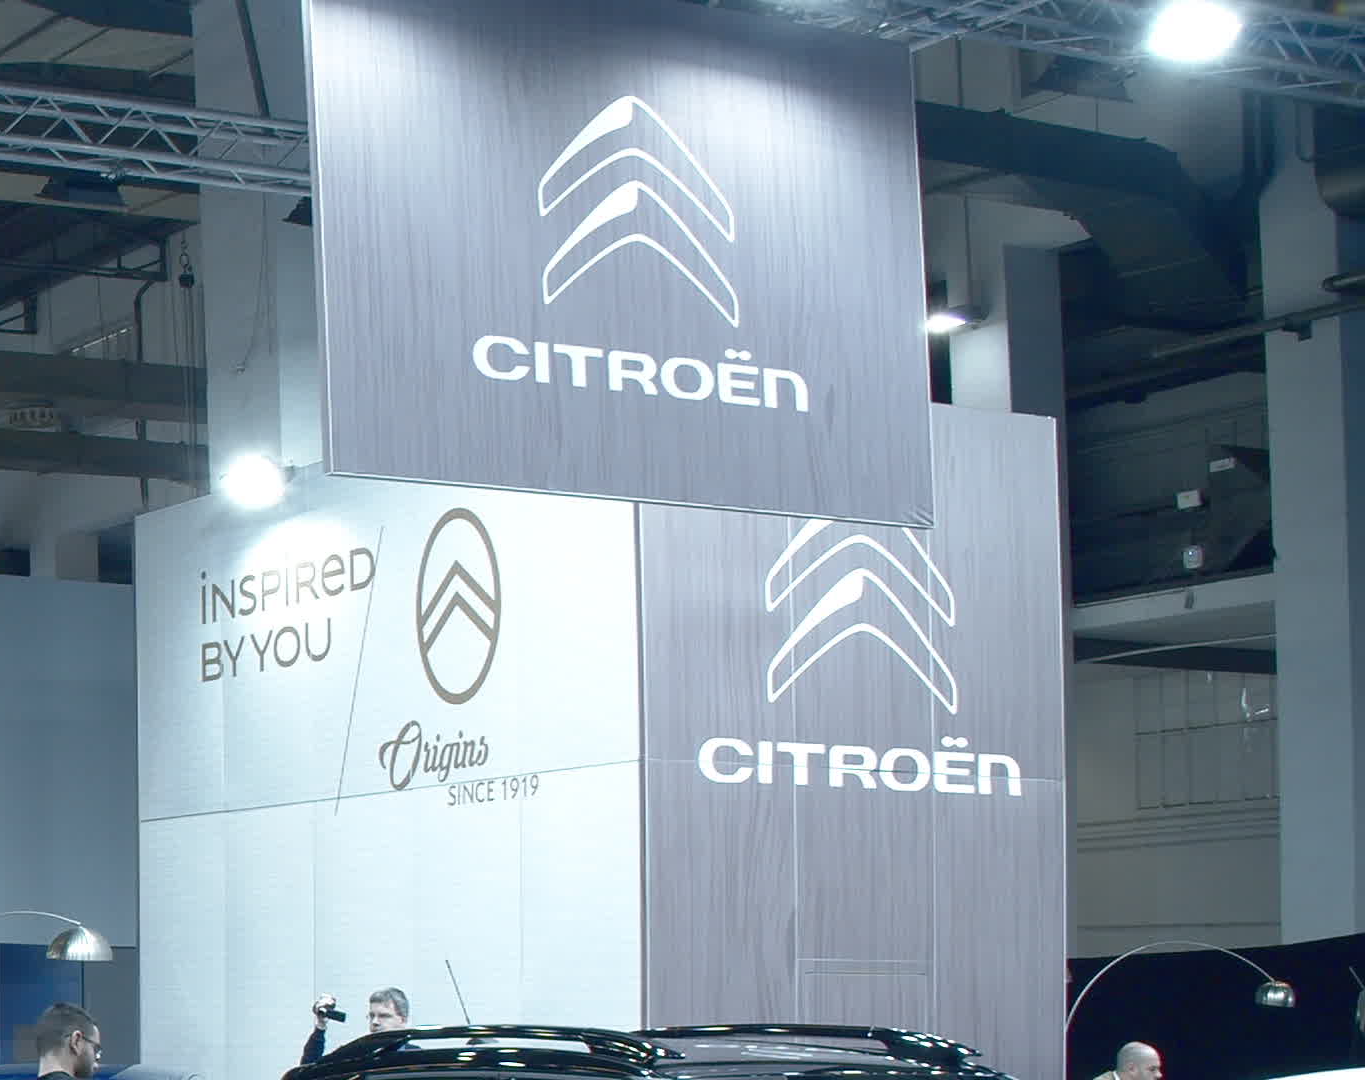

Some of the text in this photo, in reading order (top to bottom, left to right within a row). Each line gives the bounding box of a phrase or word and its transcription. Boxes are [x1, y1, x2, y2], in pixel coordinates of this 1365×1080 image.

[471, 335, 810, 412] CITROËN
[201, 617, 332, 682] BY YOU
[379, 720, 488, 791] Origins
[698, 736, 1023, 797] CITROËN
[447, 774, 540, 807] SINCE 1919
